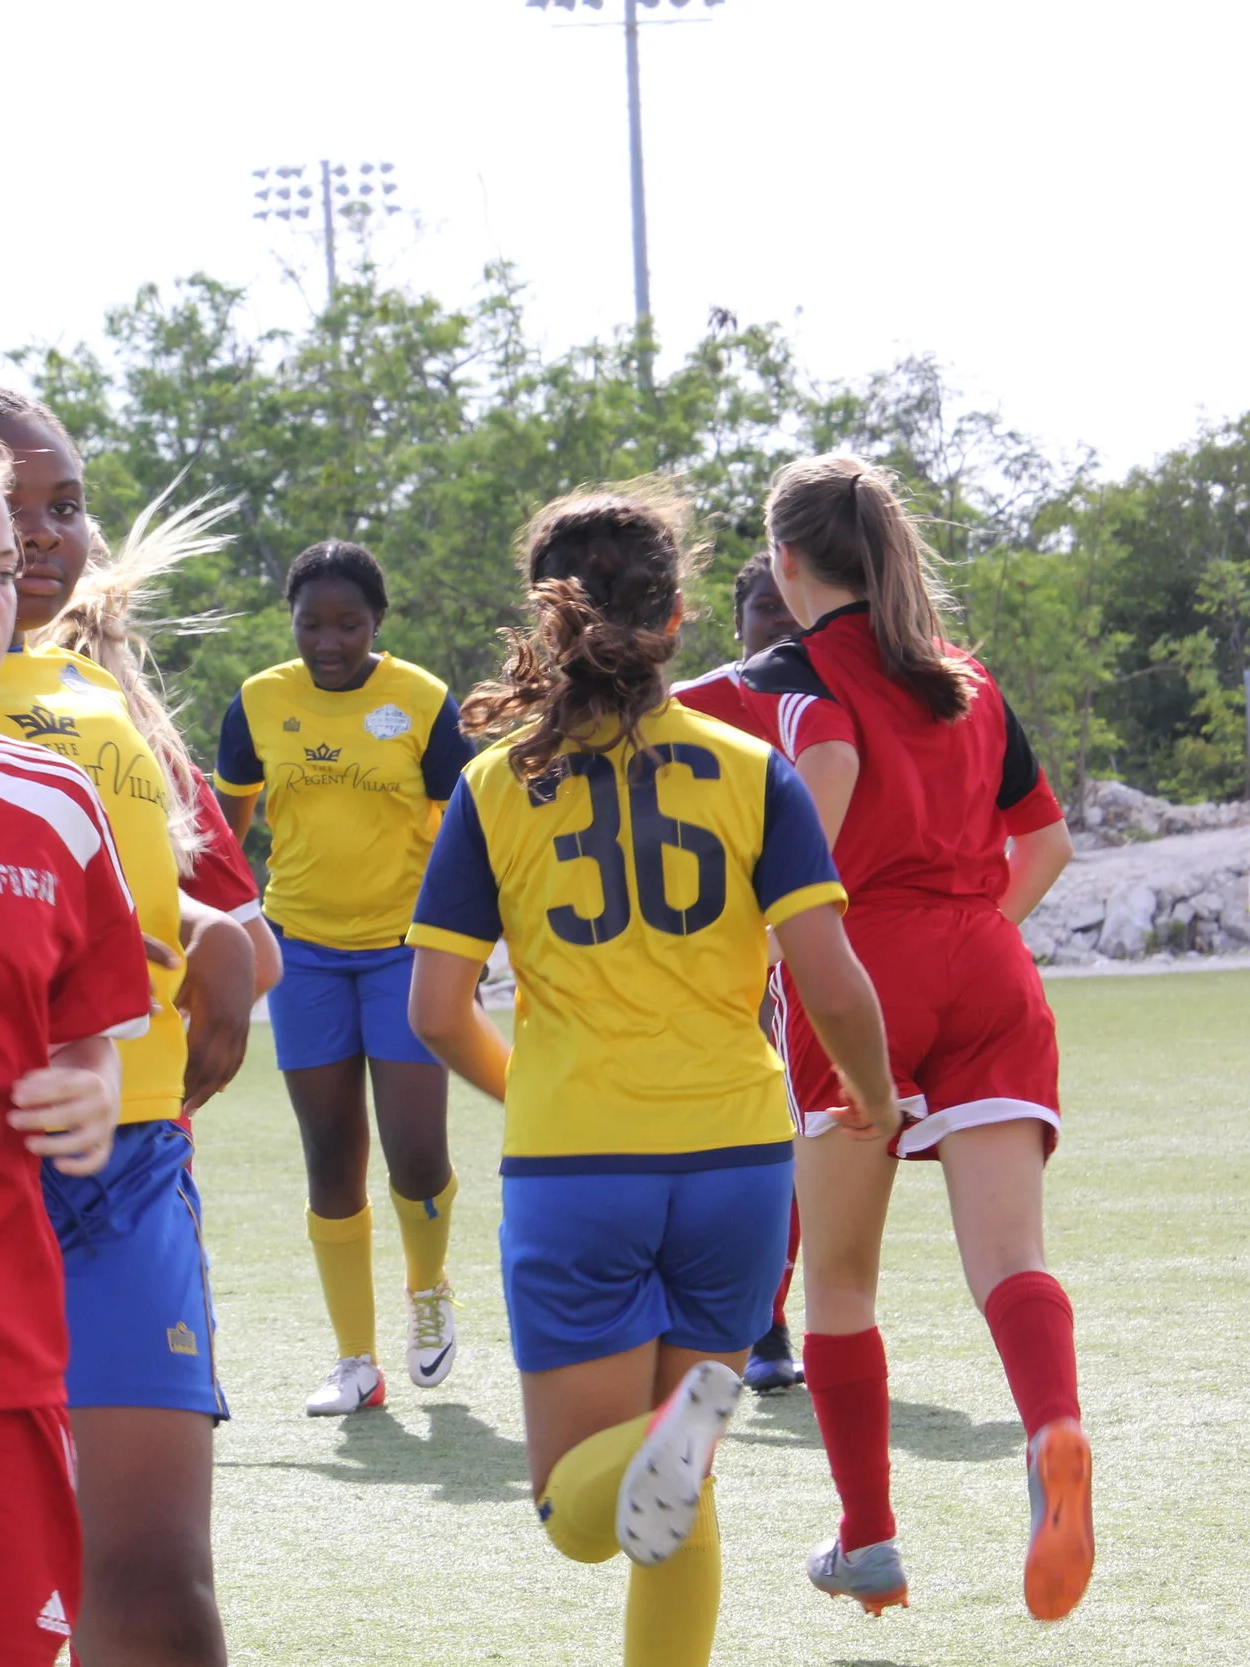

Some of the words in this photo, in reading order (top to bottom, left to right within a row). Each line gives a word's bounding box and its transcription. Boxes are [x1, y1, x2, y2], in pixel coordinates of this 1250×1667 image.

[276, 762, 345, 794] REGENT
[344, 762, 402, 793] VILLAGE
[528, 741, 727, 946] 36
